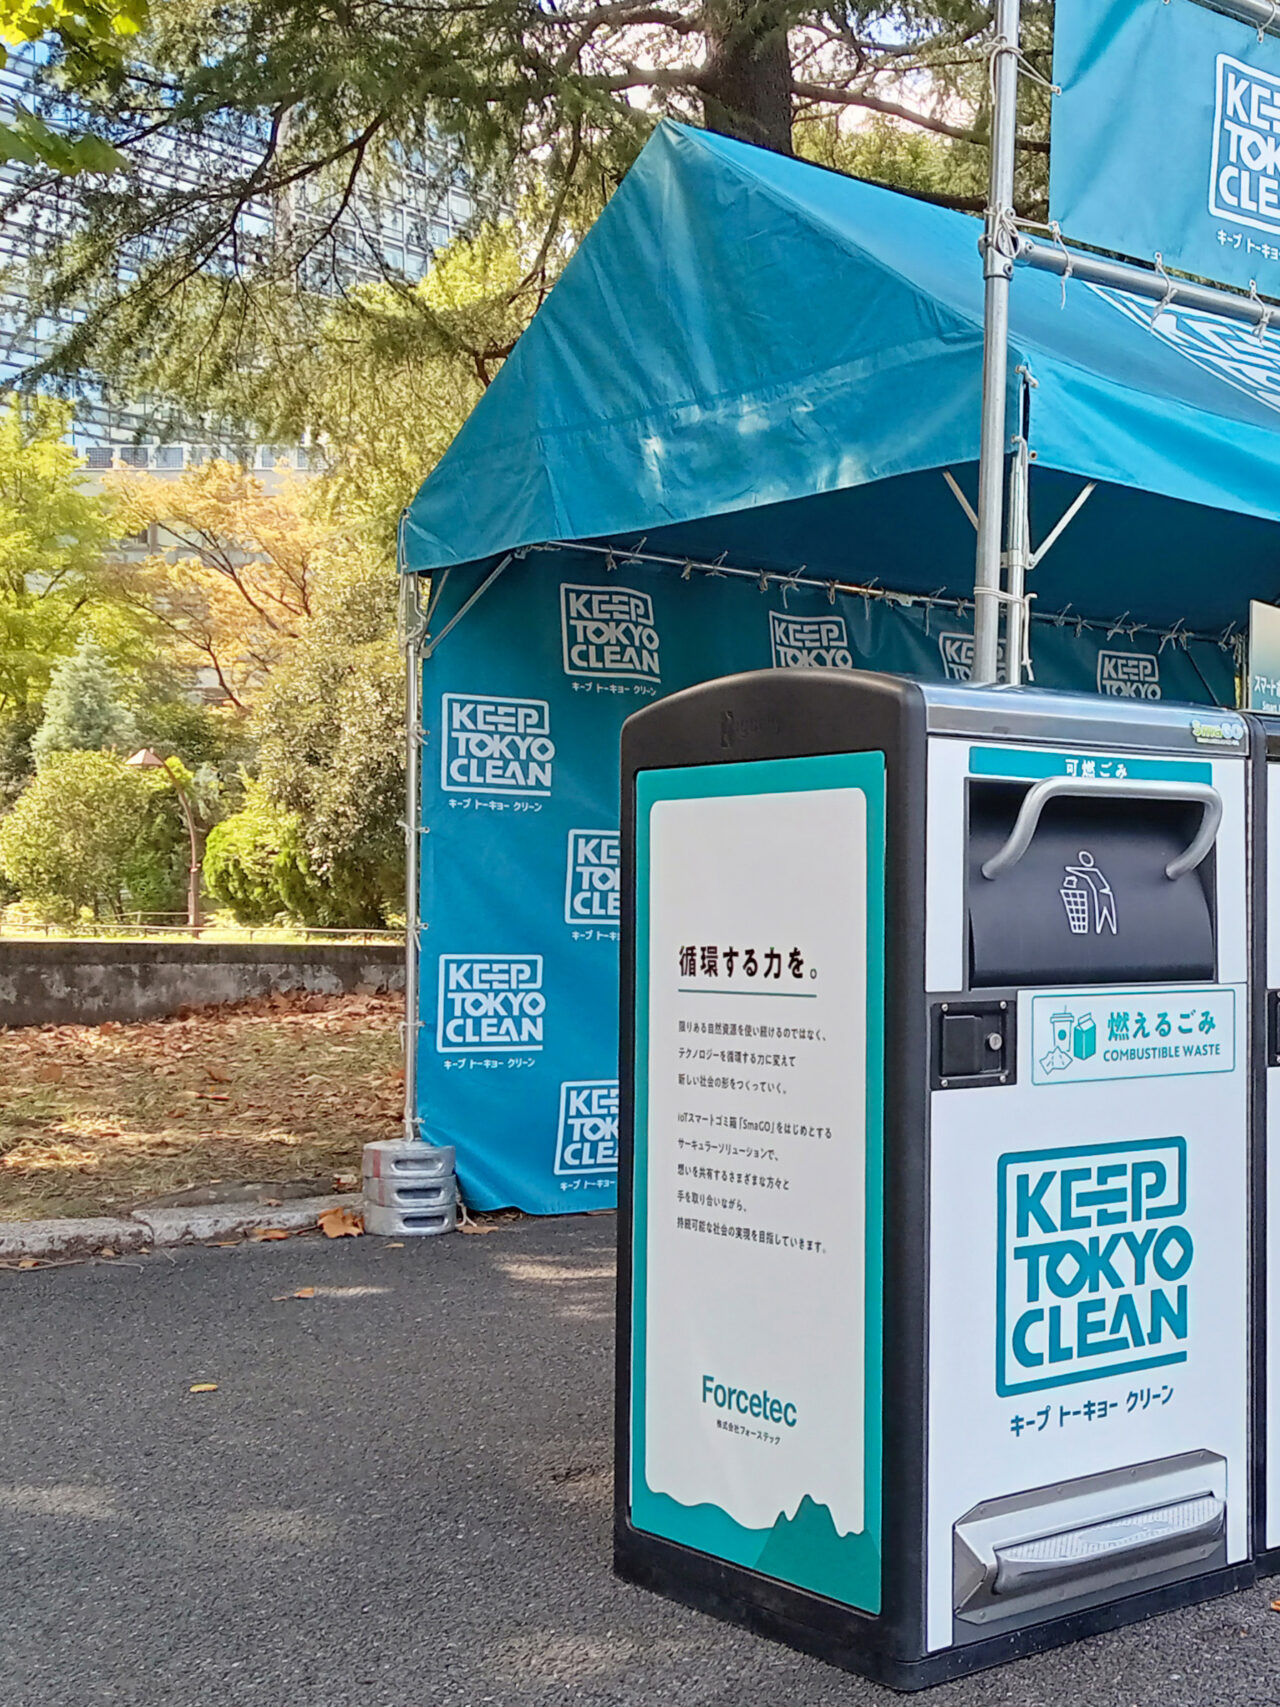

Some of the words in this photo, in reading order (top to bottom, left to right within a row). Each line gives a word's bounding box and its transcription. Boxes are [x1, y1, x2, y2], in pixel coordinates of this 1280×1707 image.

[1217, 229, 1243, 249] キープ
[569, 592, 645, 622] KEEP
[569, 618, 660, 651] TOKYO
[774, 619, 840, 647] KEEP
[570, 644, 661, 674] CLEAN
[776, 644, 853, 669] TOKYO
[1103, 657, 1151, 681] KEEP
[1102, 680, 1161, 699] TOKYO
[452, 702, 539, 734] KEEP
[450, 731, 556, 762] TOKYO
[450, 757, 551, 787] CLEAN
[1065, 758, 1128, 779] 可燃ごみ
[448, 798, 471, 810] キープ
[474, 799, 509, 811] トーキョー
[513, 801, 542, 812] クリーン
[577, 838, 620, 865] KE
[573, 891, 620, 915] CLE
[678, 945, 817, 979] 循環する力を。
[449, 963, 532, 990] KEEP
[448, 992, 546, 1017] TOKYO
[446, 1017, 543, 1043] CLEAN
[1107, 1009, 1216, 1041] 燃えるごみ
[443, 1058, 467, 1070] キープ
[469, 1059, 504, 1069] トーキョー
[507, 1057, 536, 1069] クリーン
[1103, 1045, 1180, 1062] COMBUSTIBLE
[1182, 1043, 1221, 1057] WASTE
[569, 1088, 619, 1116] KEE
[567, 1117, 619, 1141] TOK
[1016, 1160, 1167, 1239] KEEP
[1013, 1225, 1194, 1303] TOKYO
[1011, 1284, 1188, 1368] CLEAN
[702, 1374, 797, 1427] Forcetec
[1010, 1405, 1051, 1438] キープ
[1059, 1398, 1118, 1427] トーキョー
[1126, 1384, 1174, 1414] クリーン
